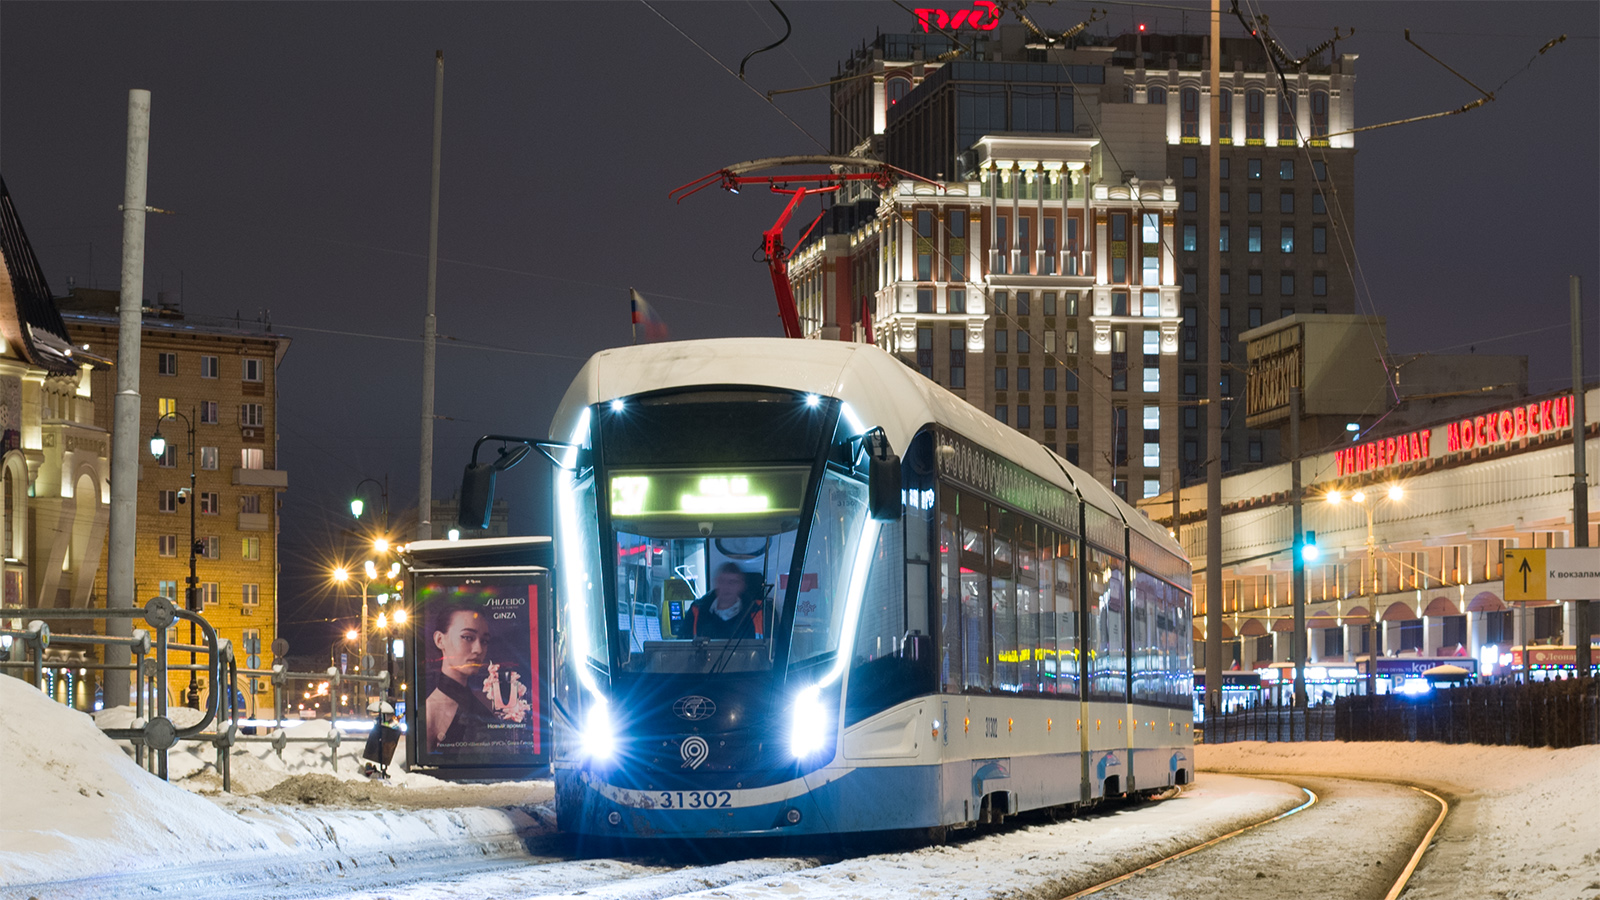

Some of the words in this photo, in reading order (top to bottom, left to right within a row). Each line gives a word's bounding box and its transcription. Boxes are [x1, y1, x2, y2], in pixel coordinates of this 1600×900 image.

[1335, 429, 1431, 477] УНИВЕРМАГ
[1447, 395, 1575, 452] МОСКОВСКИ
[1549, 570, 1556, 578] К
[484, 598, 525, 606] SHISEIDO
[659, 791, 732, 808] 31302
